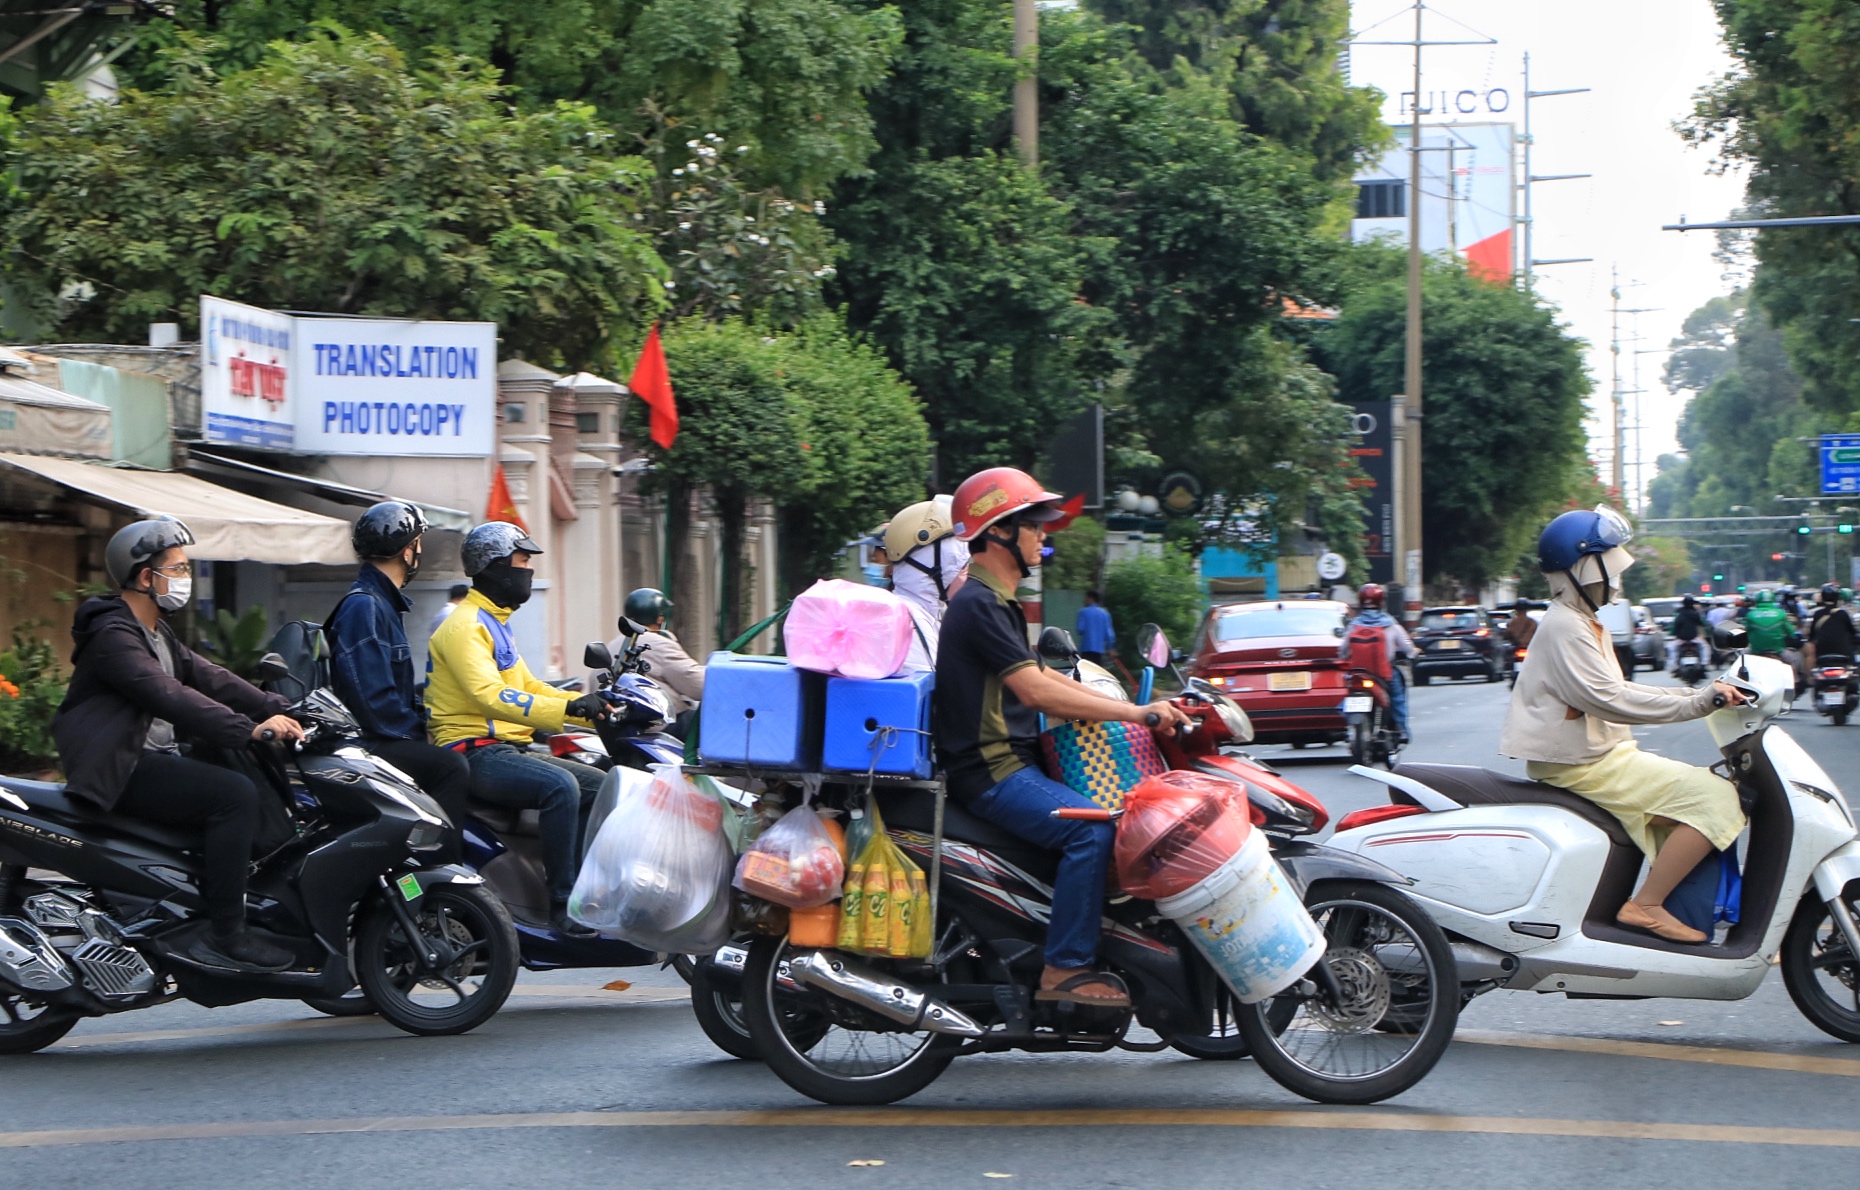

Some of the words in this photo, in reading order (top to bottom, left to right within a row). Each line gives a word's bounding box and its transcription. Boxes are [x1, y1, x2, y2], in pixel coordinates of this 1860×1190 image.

[314, 343, 478, 379] TRANSLATION
[323, 401, 466, 436] PHOTOCOPY
[350, 840, 389, 848] HONDA
[869, 895, 887, 917] C2
